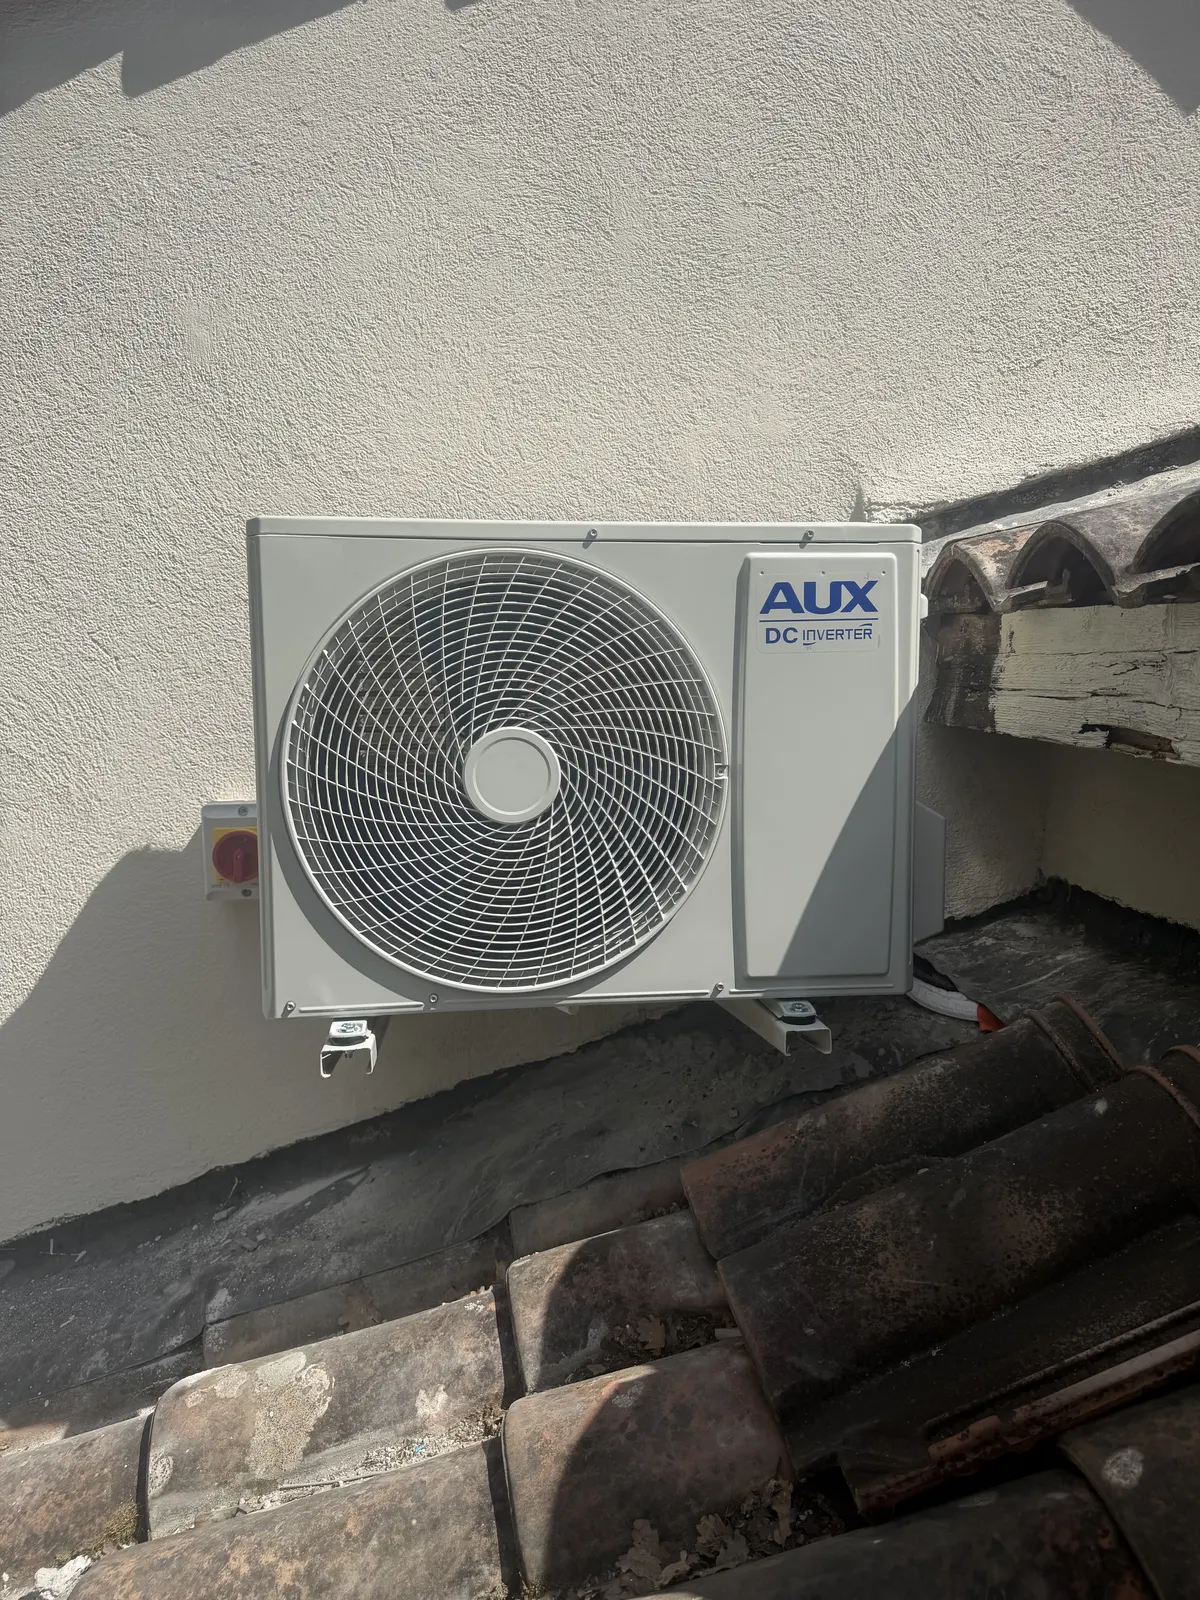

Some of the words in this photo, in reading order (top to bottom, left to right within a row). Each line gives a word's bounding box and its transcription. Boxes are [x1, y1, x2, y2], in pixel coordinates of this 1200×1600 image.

[759, 580, 879, 615] AUX
[765, 627, 798, 644] DC
[802, 625, 873, 643] INVERTER
